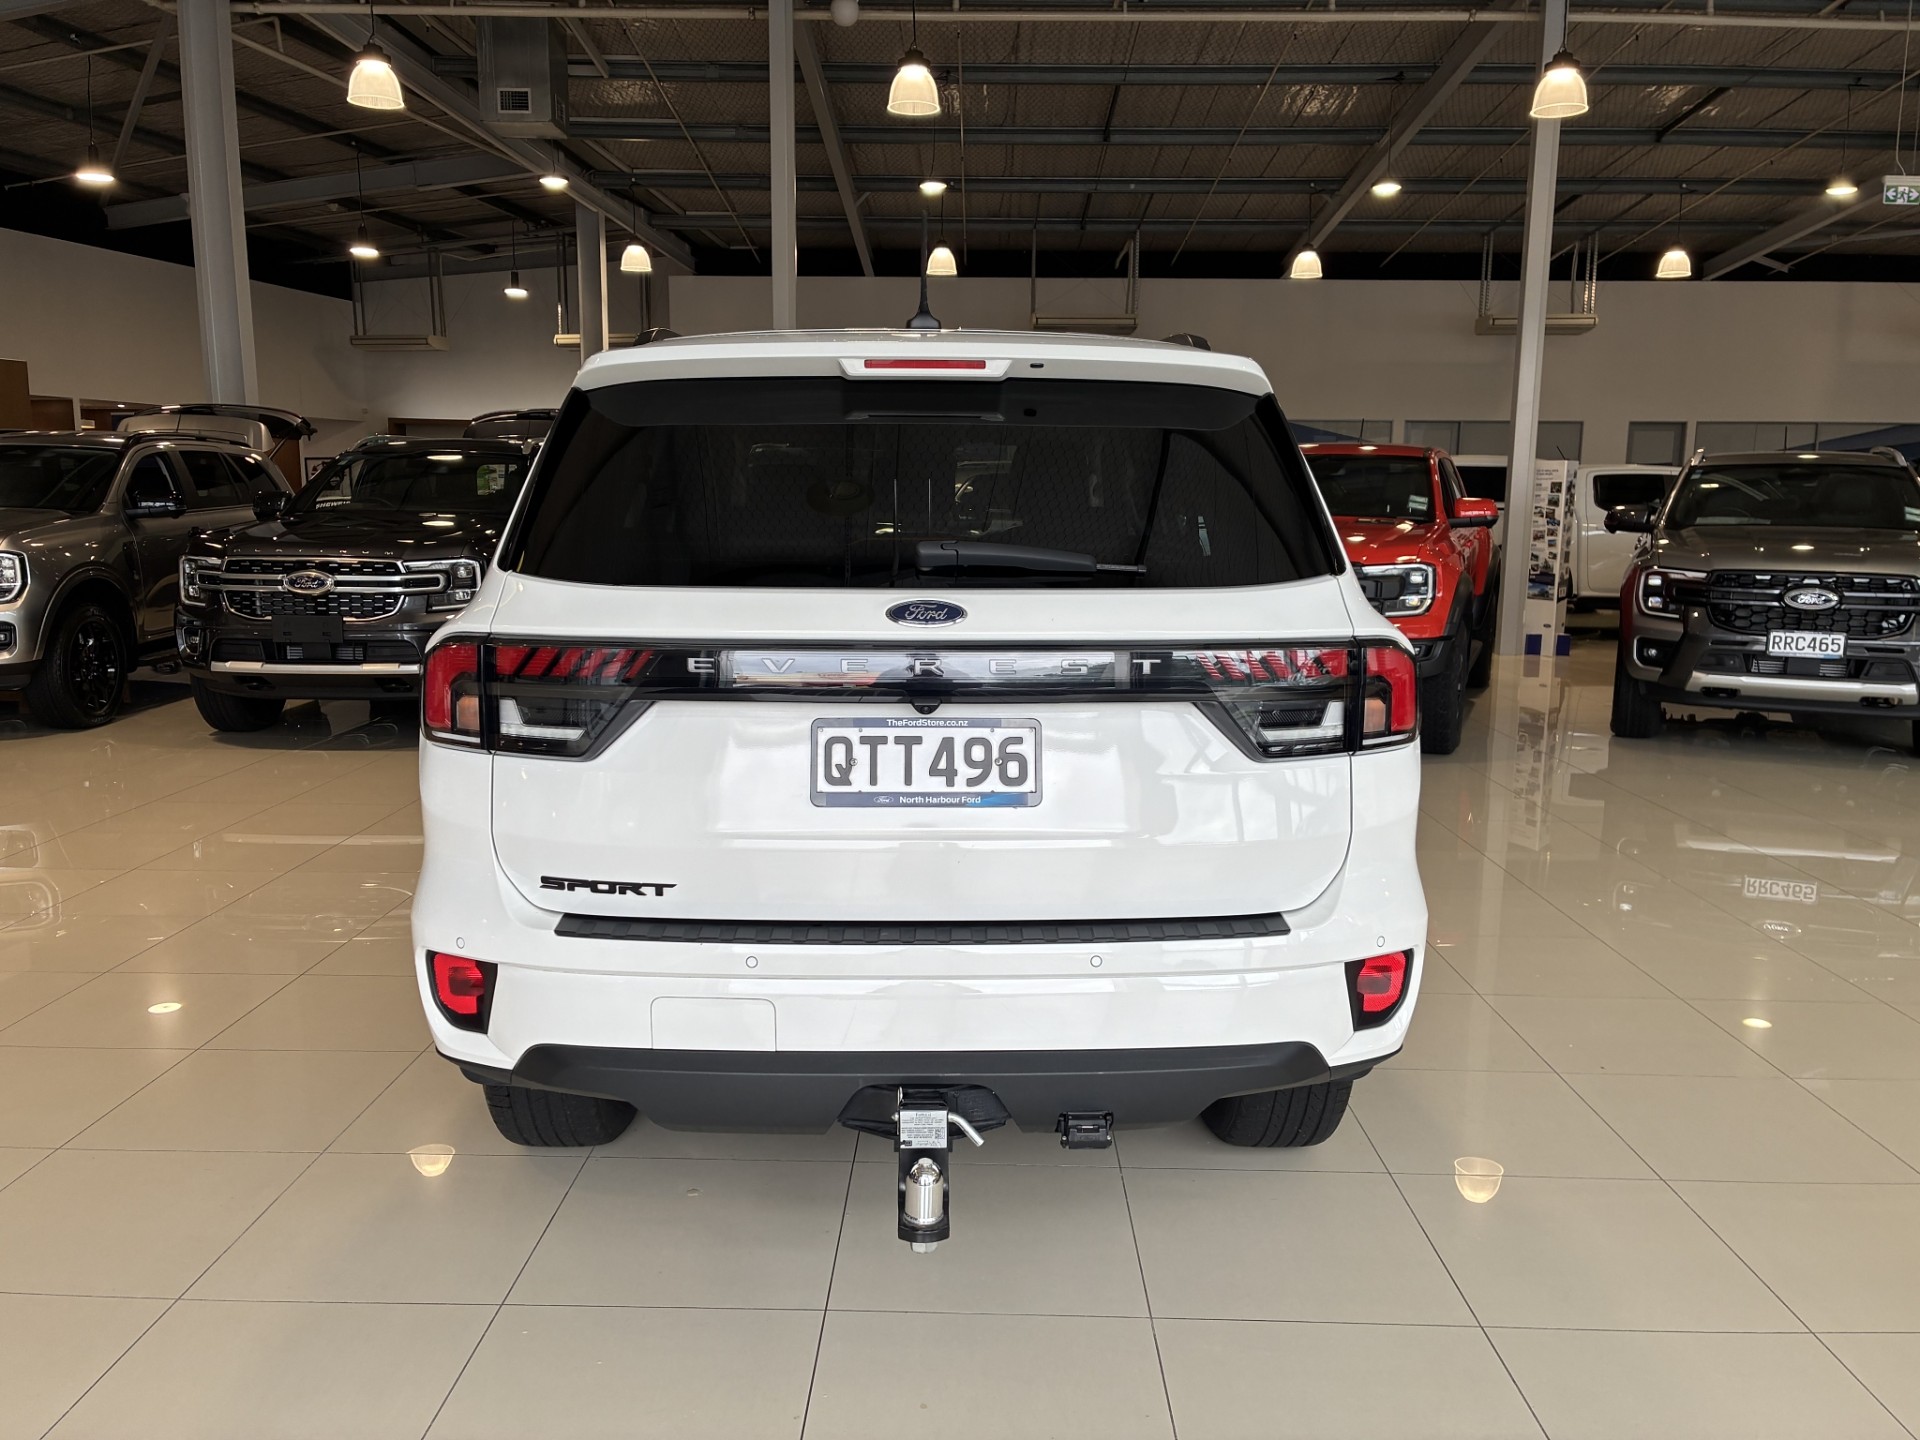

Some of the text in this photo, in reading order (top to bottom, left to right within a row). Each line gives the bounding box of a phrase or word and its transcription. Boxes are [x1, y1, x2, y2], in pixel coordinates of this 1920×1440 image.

[294, 577, 319, 588] Ford
[1797, 592, 1826, 605] Ford
[904, 603, 949, 620] Ford
[1771, 635, 1842, 653] RRC465
[686, 657, 1162, 676] EVEREST
[886, 719, 969, 727] TheFordStore.co.nz
[824, 735, 1029, 788] QTT496
[899, 796, 924, 804] North
[925, 796, 961, 804] Harbour
[962, 796, 982, 804] Ford
[539, 875, 678, 897] SPORT
